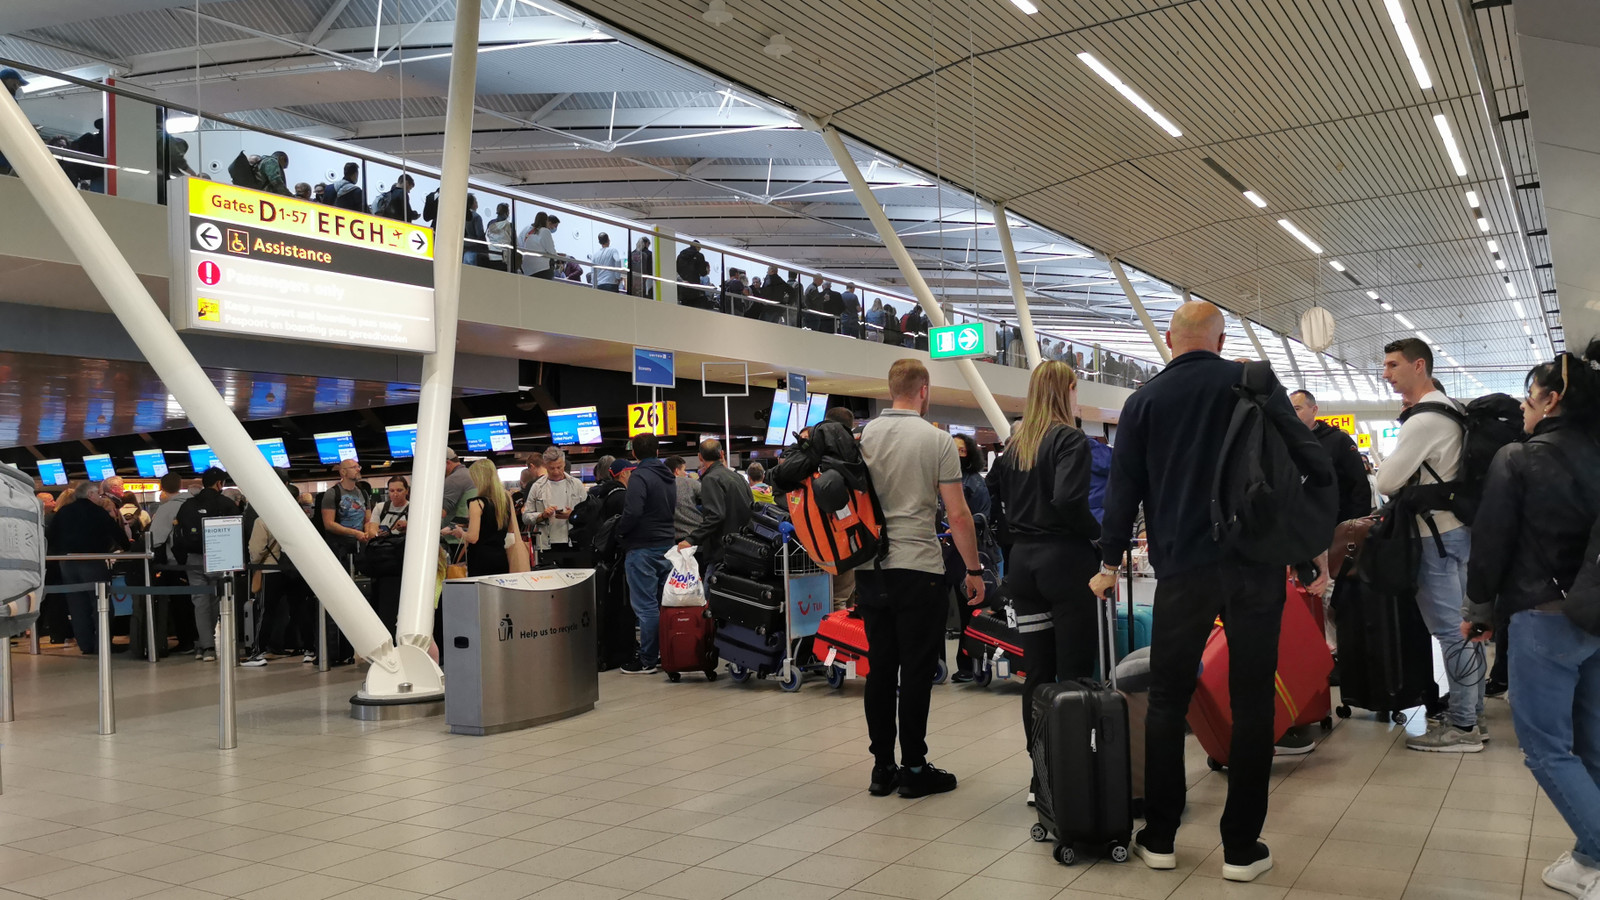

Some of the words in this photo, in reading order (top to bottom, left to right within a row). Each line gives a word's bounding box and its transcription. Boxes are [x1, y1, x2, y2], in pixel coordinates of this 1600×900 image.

[211, 194, 254, 214] Gates
[253, 238, 332, 264] Assistance
[225, 269, 310, 294] Passengers
[313, 283, 345, 301] only
[224, 314, 269, 330] Paspoort
[285, 322, 327, 337] boarding
[633, 405, 659, 429] 26
[812, 601, 823, 612] TUI
[520, 629, 538, 639] Help
[540, 628, 548, 636] us
[550, 627, 557, 635] to
[558, 622, 578, 634] recycle
